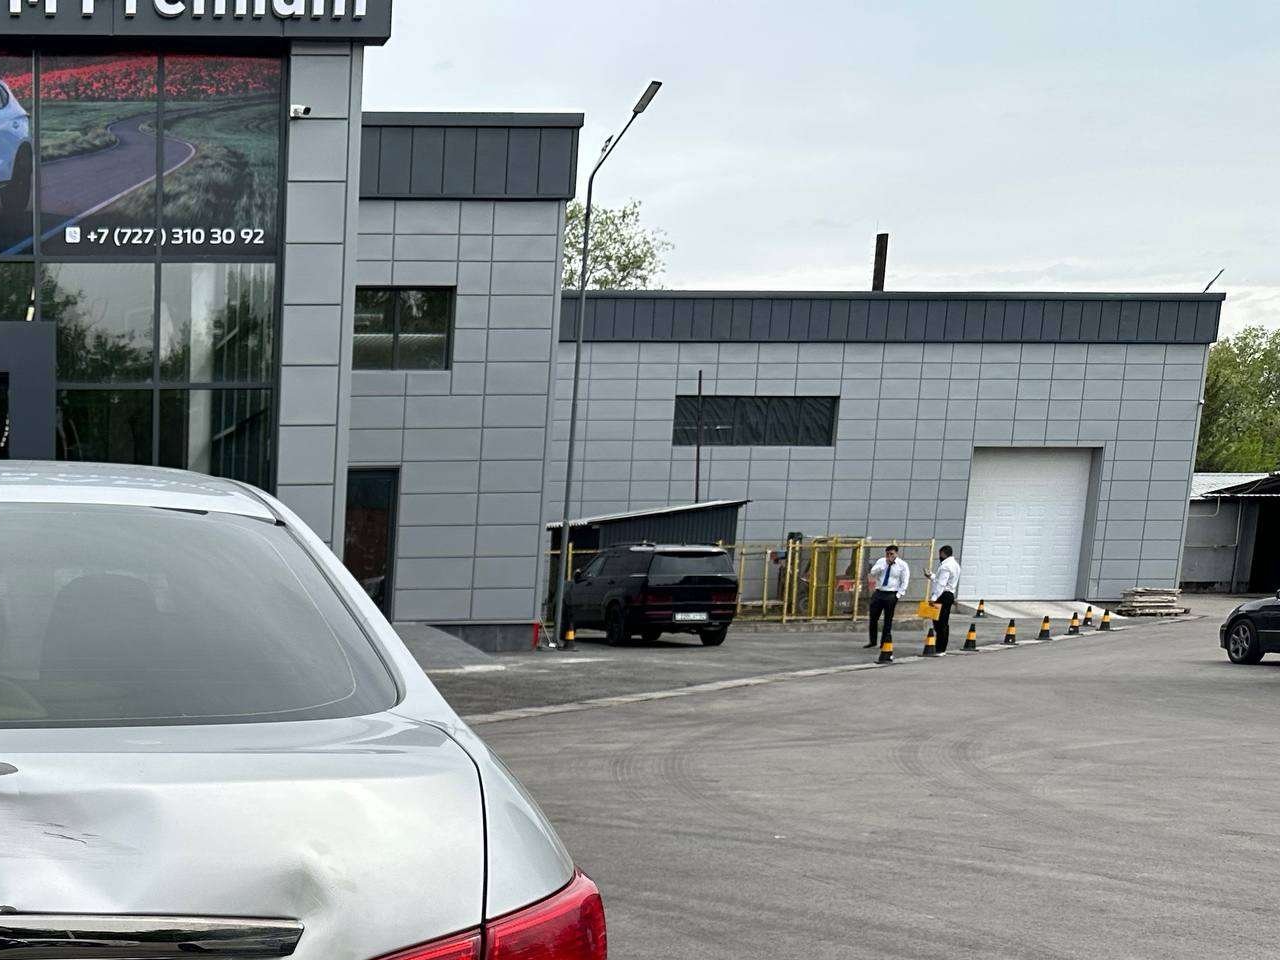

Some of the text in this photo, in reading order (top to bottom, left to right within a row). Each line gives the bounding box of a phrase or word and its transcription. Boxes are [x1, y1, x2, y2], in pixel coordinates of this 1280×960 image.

[87, 229, 109, 244] +7
[171, 229, 205, 244] 310
[209, 229, 235, 244] 30
[241, 229, 264, 244] 92
